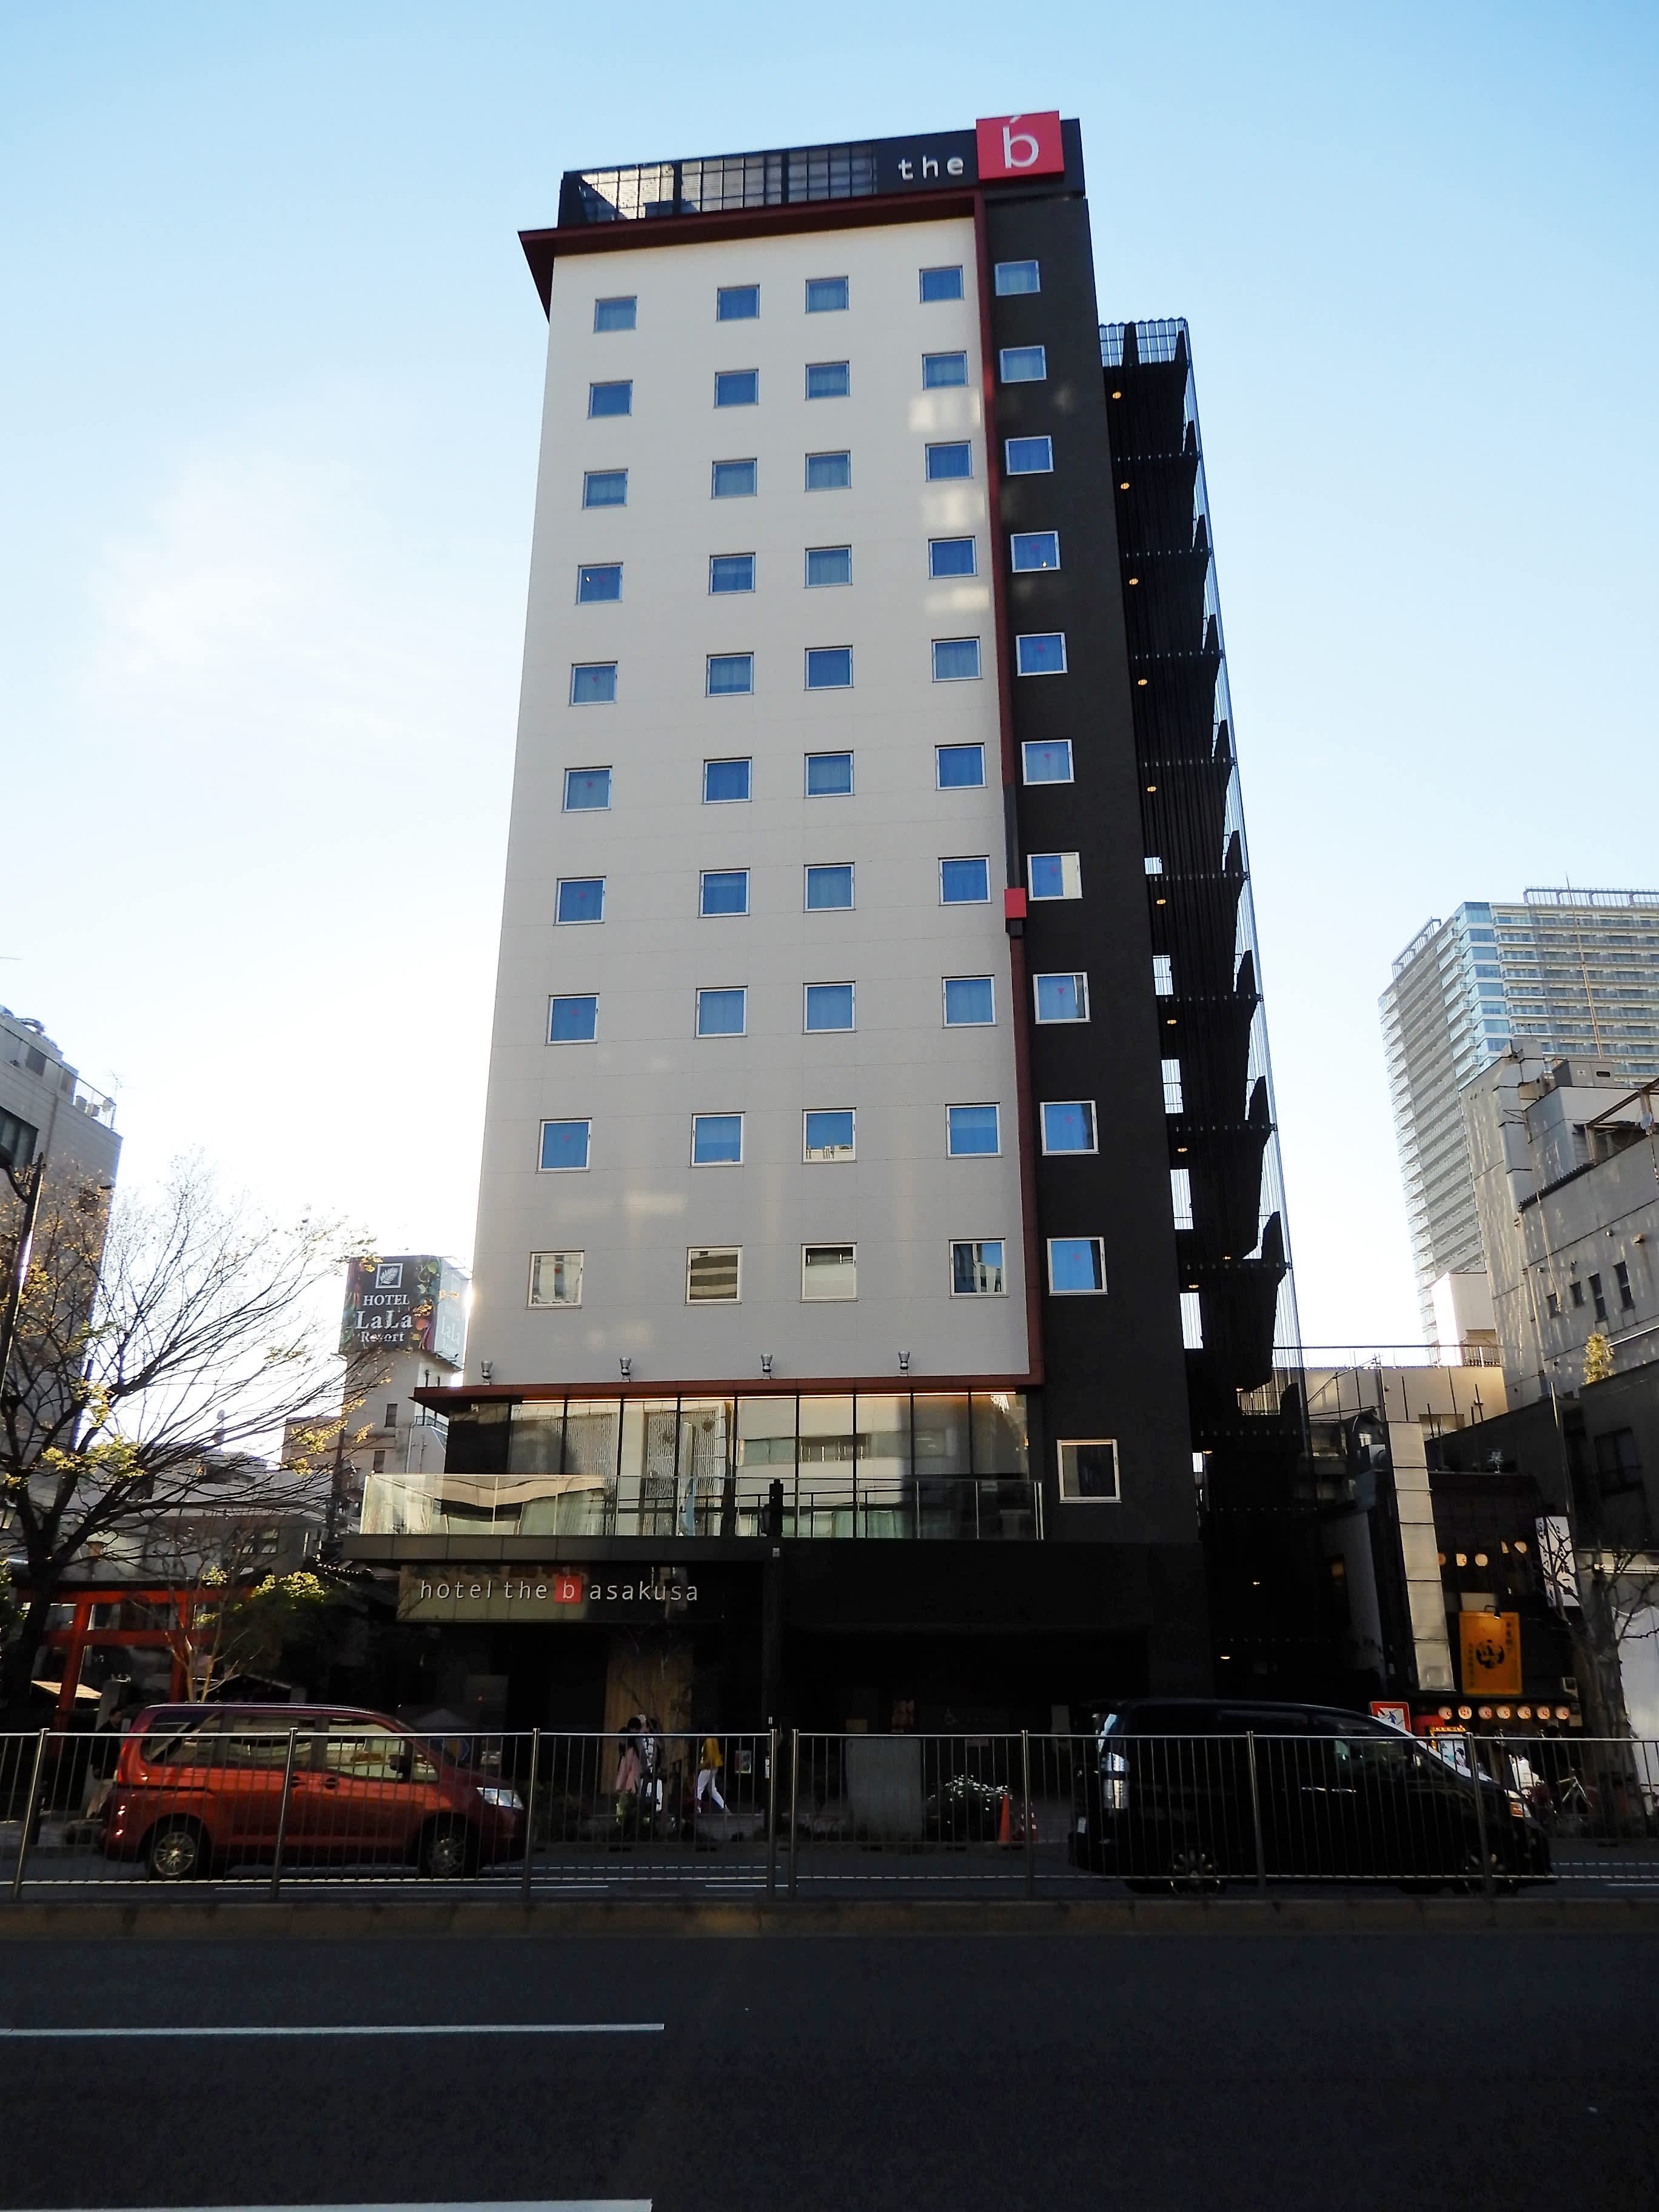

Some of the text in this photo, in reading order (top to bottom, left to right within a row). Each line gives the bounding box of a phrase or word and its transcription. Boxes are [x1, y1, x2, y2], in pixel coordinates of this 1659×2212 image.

[899, 155, 964, 181] the
[363, 1294, 411, 1305] HOTEL
[355, 1310, 413, 1330] LaLa
[420, 1580, 492, 1599] hotel
[504, 1581, 548, 1599] the
[589, 1580, 698, 1600] asakusa
